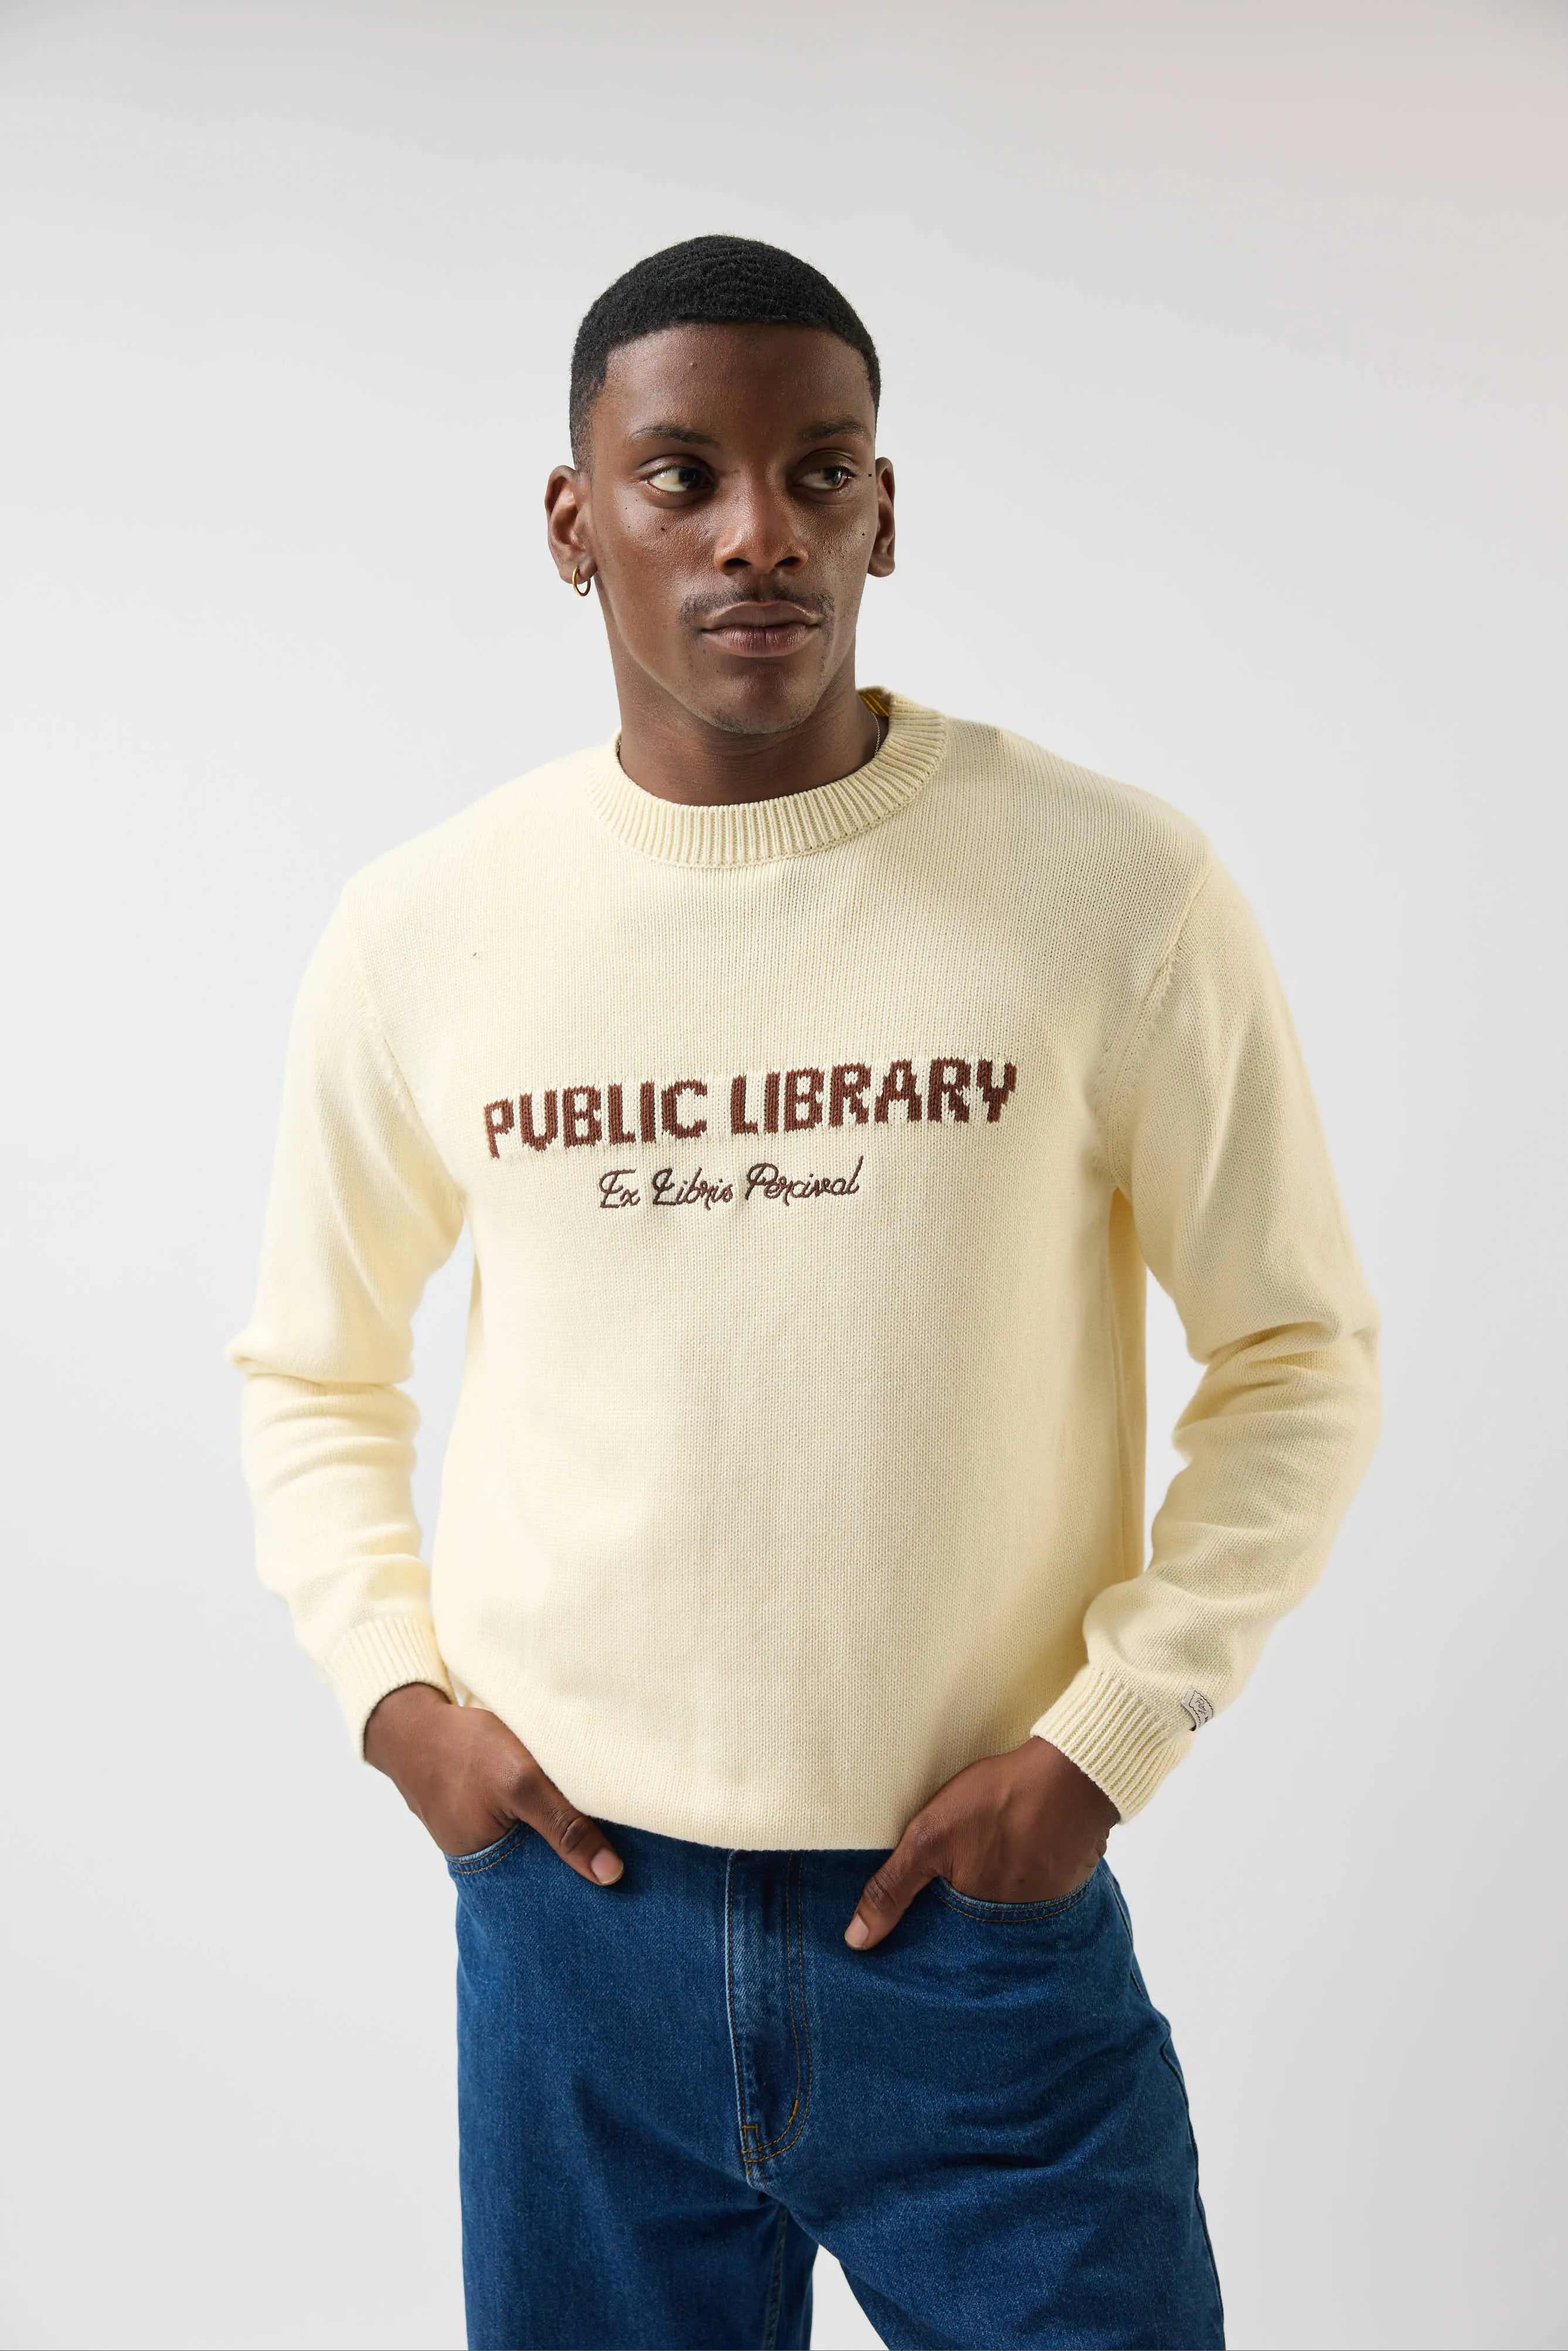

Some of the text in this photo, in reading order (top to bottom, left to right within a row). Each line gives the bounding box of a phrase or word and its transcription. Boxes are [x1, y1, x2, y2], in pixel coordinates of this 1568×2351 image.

[484, 1056, 1017, 1158] PUBLIC LIBRARY
[599, 1155, 864, 1210] Ex Libris Percival
